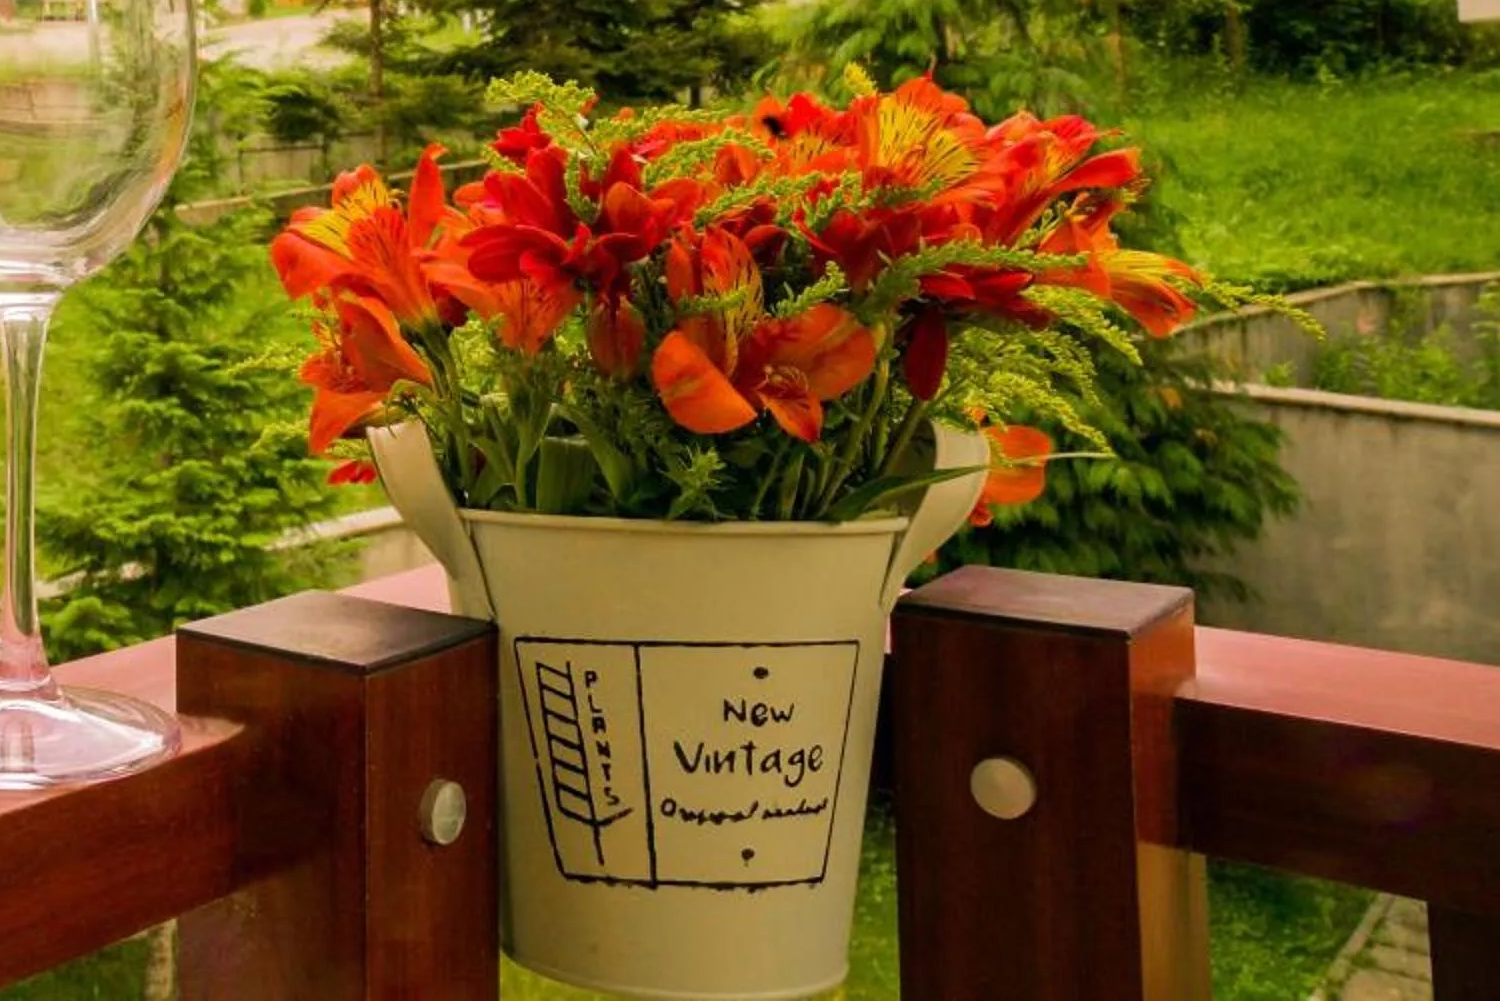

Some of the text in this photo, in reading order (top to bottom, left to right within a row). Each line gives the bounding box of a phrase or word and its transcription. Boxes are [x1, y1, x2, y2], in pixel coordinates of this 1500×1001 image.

[722, 698, 795, 727] New
[584, 670, 620, 806] PLANTS
[672, 740, 824, 788] Vintage
